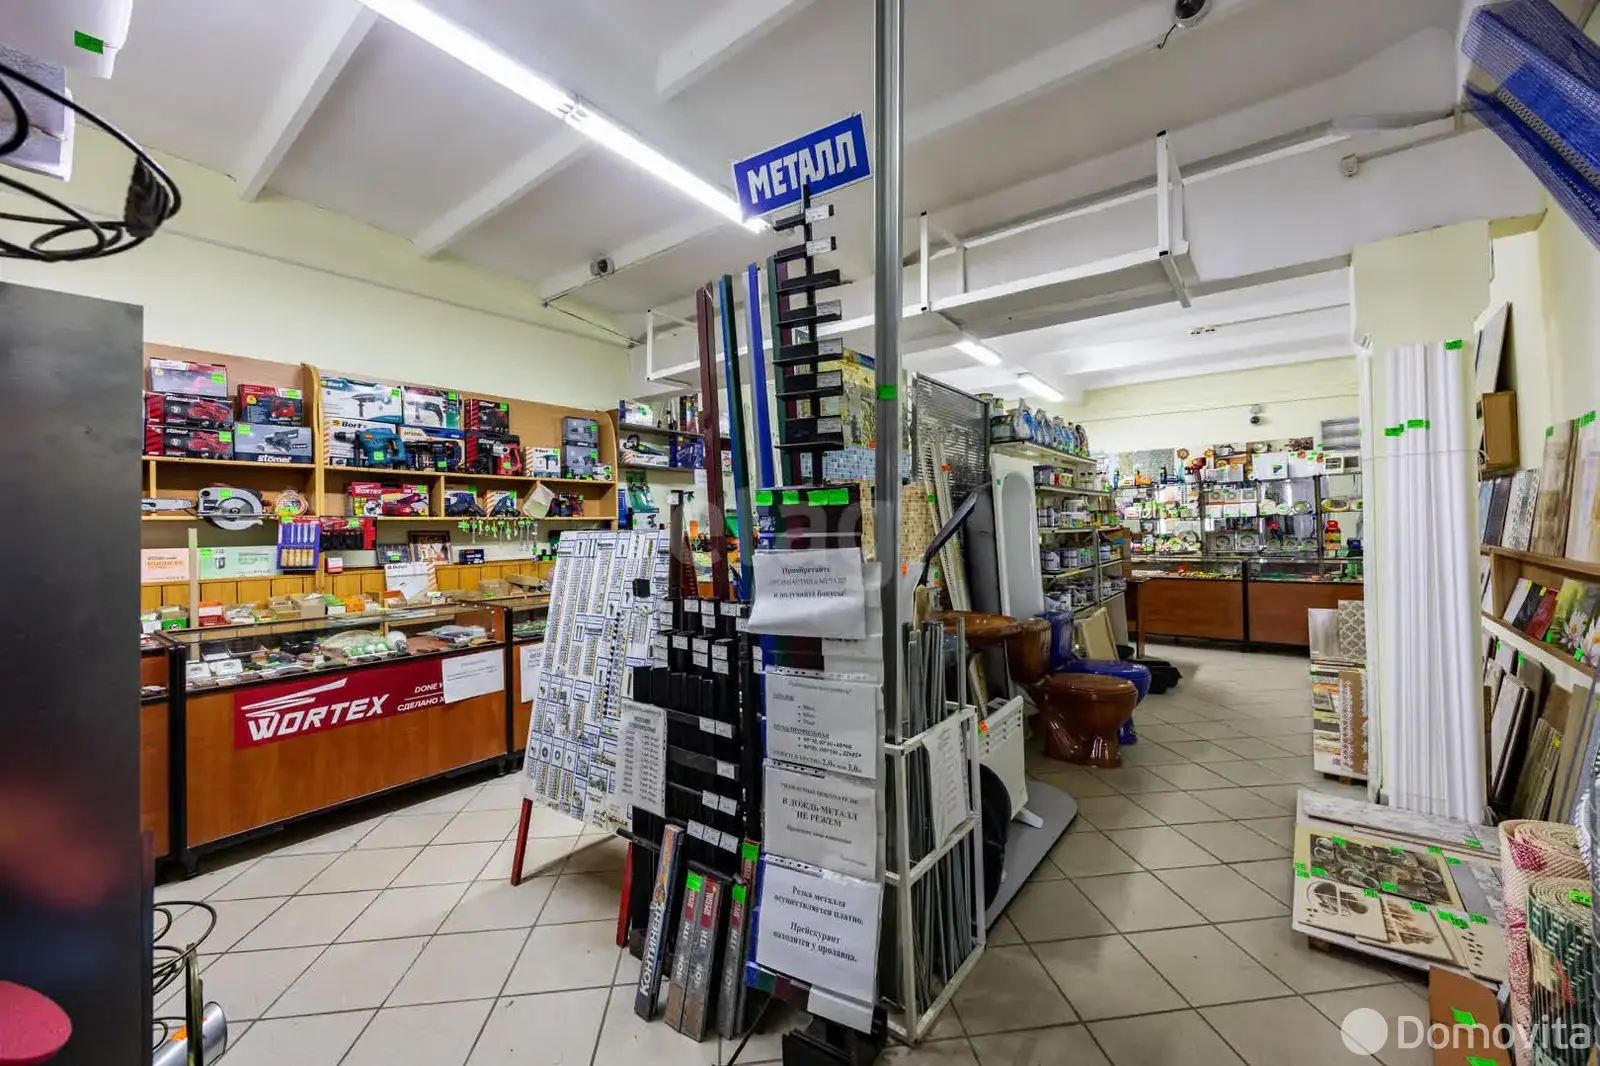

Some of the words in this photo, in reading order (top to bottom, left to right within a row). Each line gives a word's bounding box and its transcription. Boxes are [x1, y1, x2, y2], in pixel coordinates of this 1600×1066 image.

[747, 130, 857, 204] МЕТАЛЛ
[414, 682, 438, 694] DONE
[397, 697, 438, 712] СДЕЛАНО
[246, 694, 390, 742] WORTEX
[782, 797, 788, 805] В
[789, 799, 820, 812] ДОЖДЬ
[820, 805, 858, 821] МЕТАЛЛ
[796, 811, 809, 820] НЕ
[810, 814, 842, 828] РЕЖЕМ
[773, 894, 833, 917] осуществляется
[792, 885, 813, 899] Резка
[814, 893, 846, 909] металла
[772, 930, 810, 949] находится
[790, 921, 841, 945] Прейскурант
